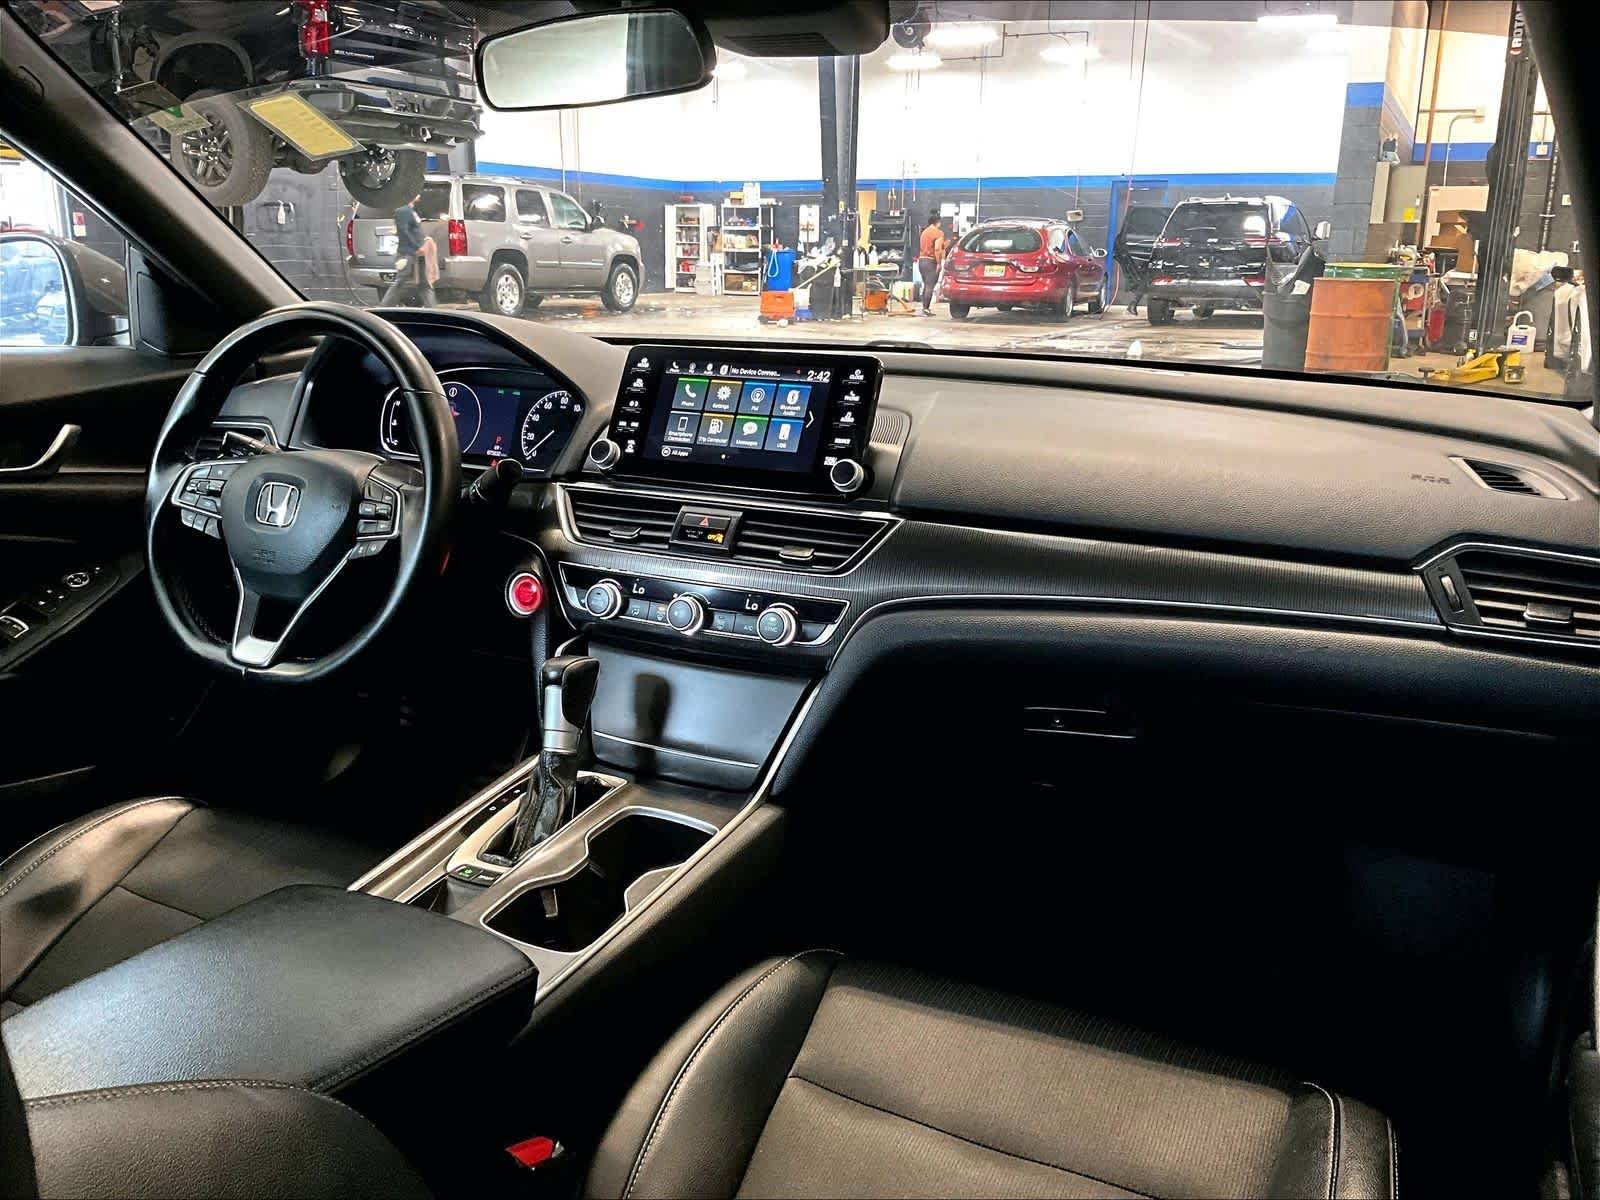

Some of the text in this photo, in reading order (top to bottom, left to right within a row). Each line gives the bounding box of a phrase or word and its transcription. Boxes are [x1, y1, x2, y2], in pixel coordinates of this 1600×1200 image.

[807, 370, 831, 382] 2:42
[560, 396, 569, 404] 80
[544, 401, 552, 410] 60
[532, 413, 540, 421] 40
[526, 432, 535, 440] 20
[632, 583, 645, 594] Lo
[745, 598, 758, 610] Lo
